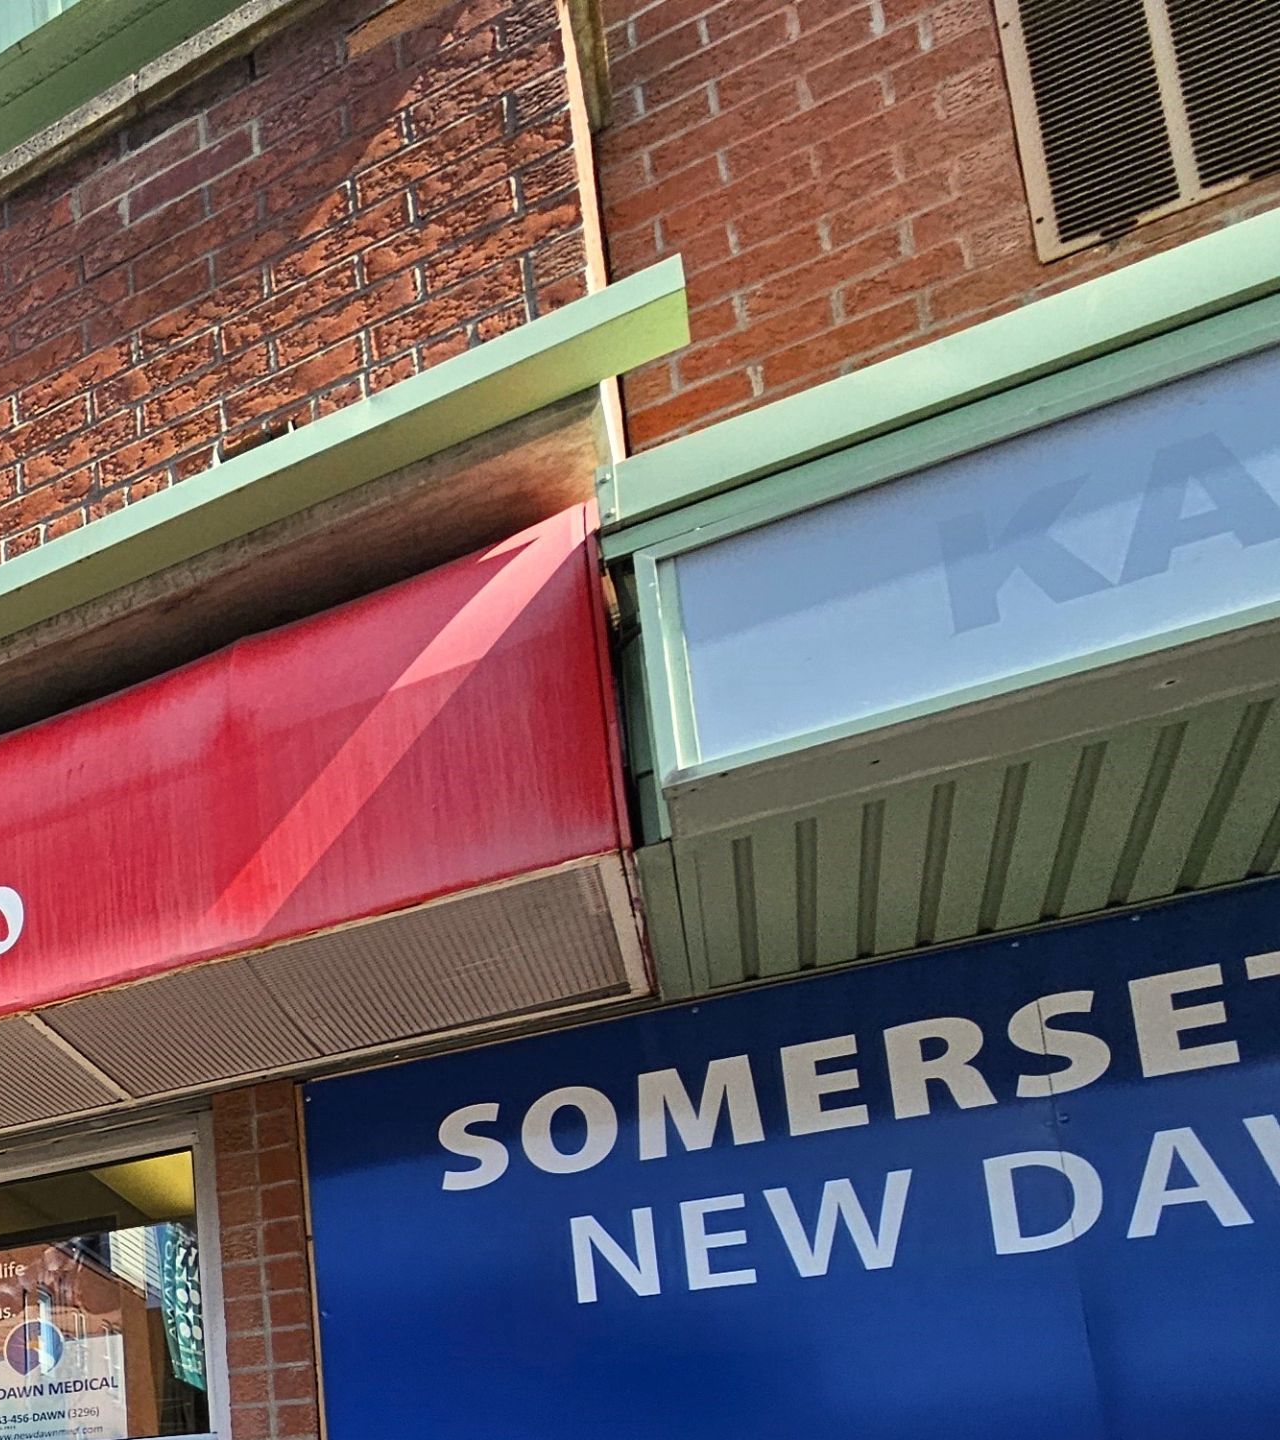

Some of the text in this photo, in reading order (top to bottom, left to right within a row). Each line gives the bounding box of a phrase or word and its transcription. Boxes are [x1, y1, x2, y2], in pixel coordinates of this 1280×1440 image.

[438, 951, 1280, 1191] SOMERSE
[570, 1115, 1280, 1304] NEW DA
[0, 1261, 25, 1279] life
[49, 1376, 119, 1395] MEDICAL
[68, 1407, 100, 1420] (3296)
